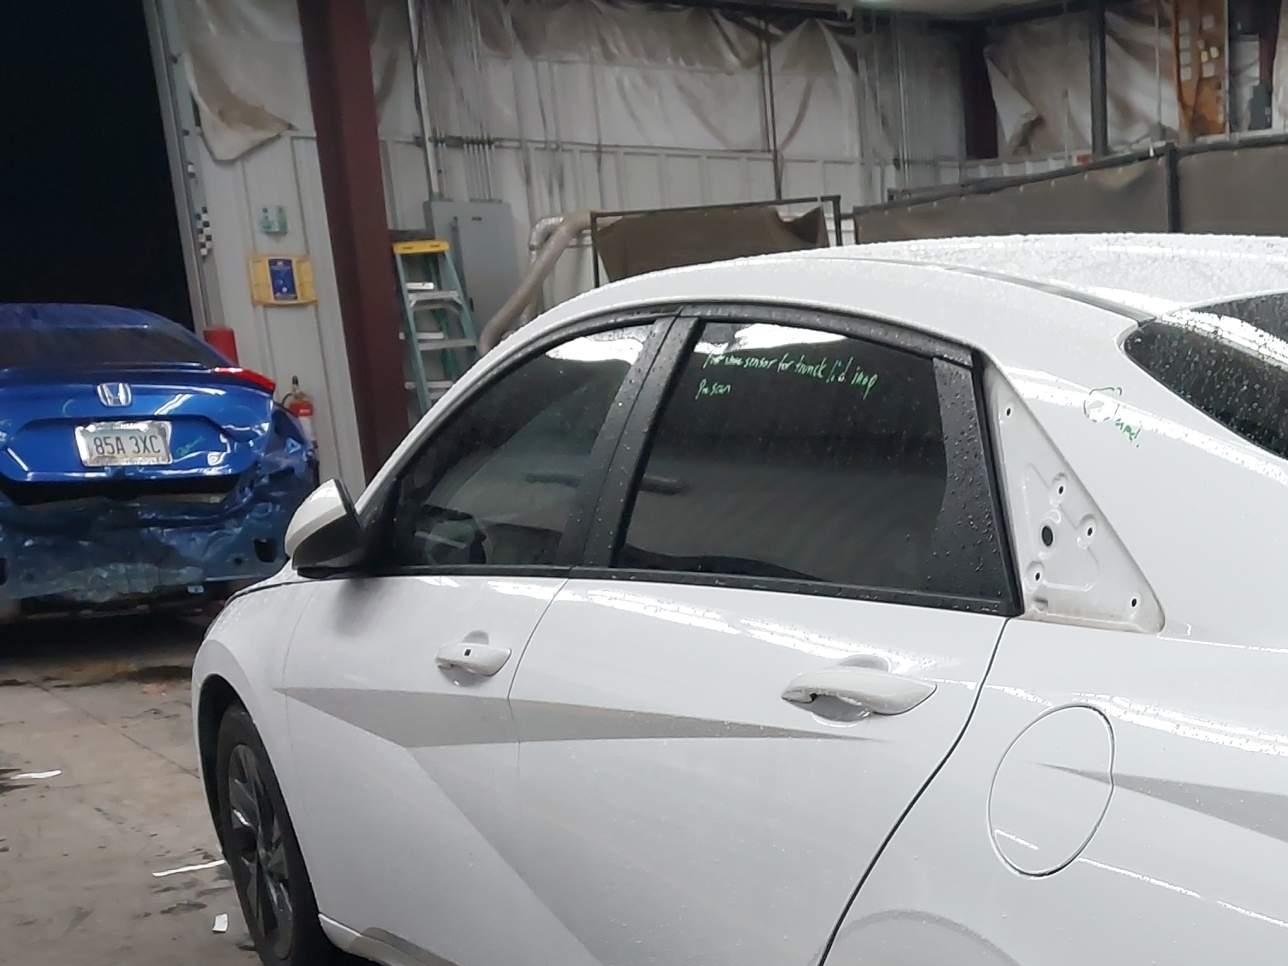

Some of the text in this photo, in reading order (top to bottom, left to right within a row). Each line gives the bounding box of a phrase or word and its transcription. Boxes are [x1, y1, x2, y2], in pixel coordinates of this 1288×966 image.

[777, 353, 795, 374] for
[93, 436, 126, 455] 85A
[129, 435, 161, 453] 3XC
